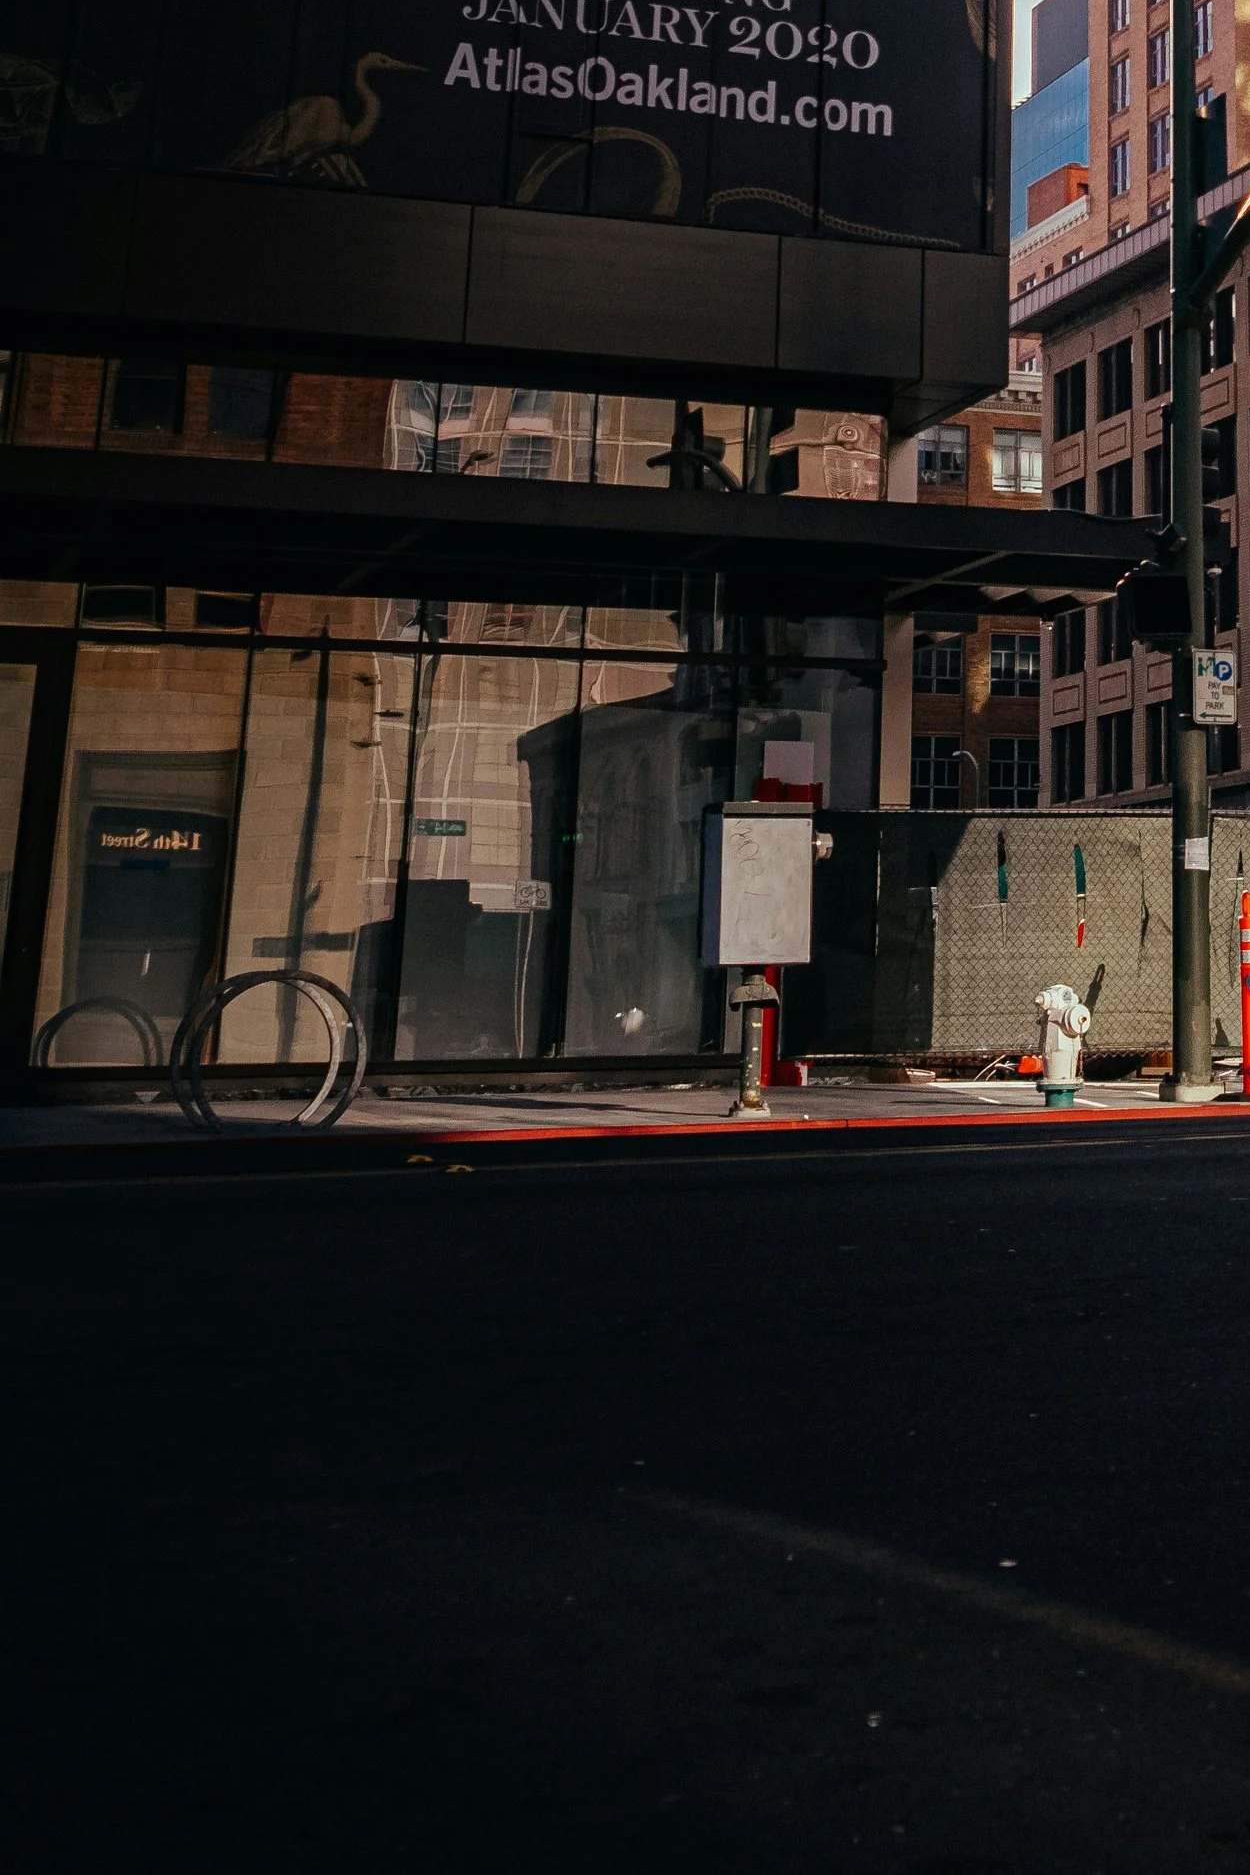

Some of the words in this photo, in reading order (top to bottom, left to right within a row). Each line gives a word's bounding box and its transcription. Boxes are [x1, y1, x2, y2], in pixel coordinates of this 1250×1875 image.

[727, 15, 880, 70] 2020
[443, 42, 894, 137] AtlasOakland.com
[1208, 682, 1221, 690] PAY
[1210, 691, 1220, 700] TO
[1205, 701, 1225, 711] PARK
